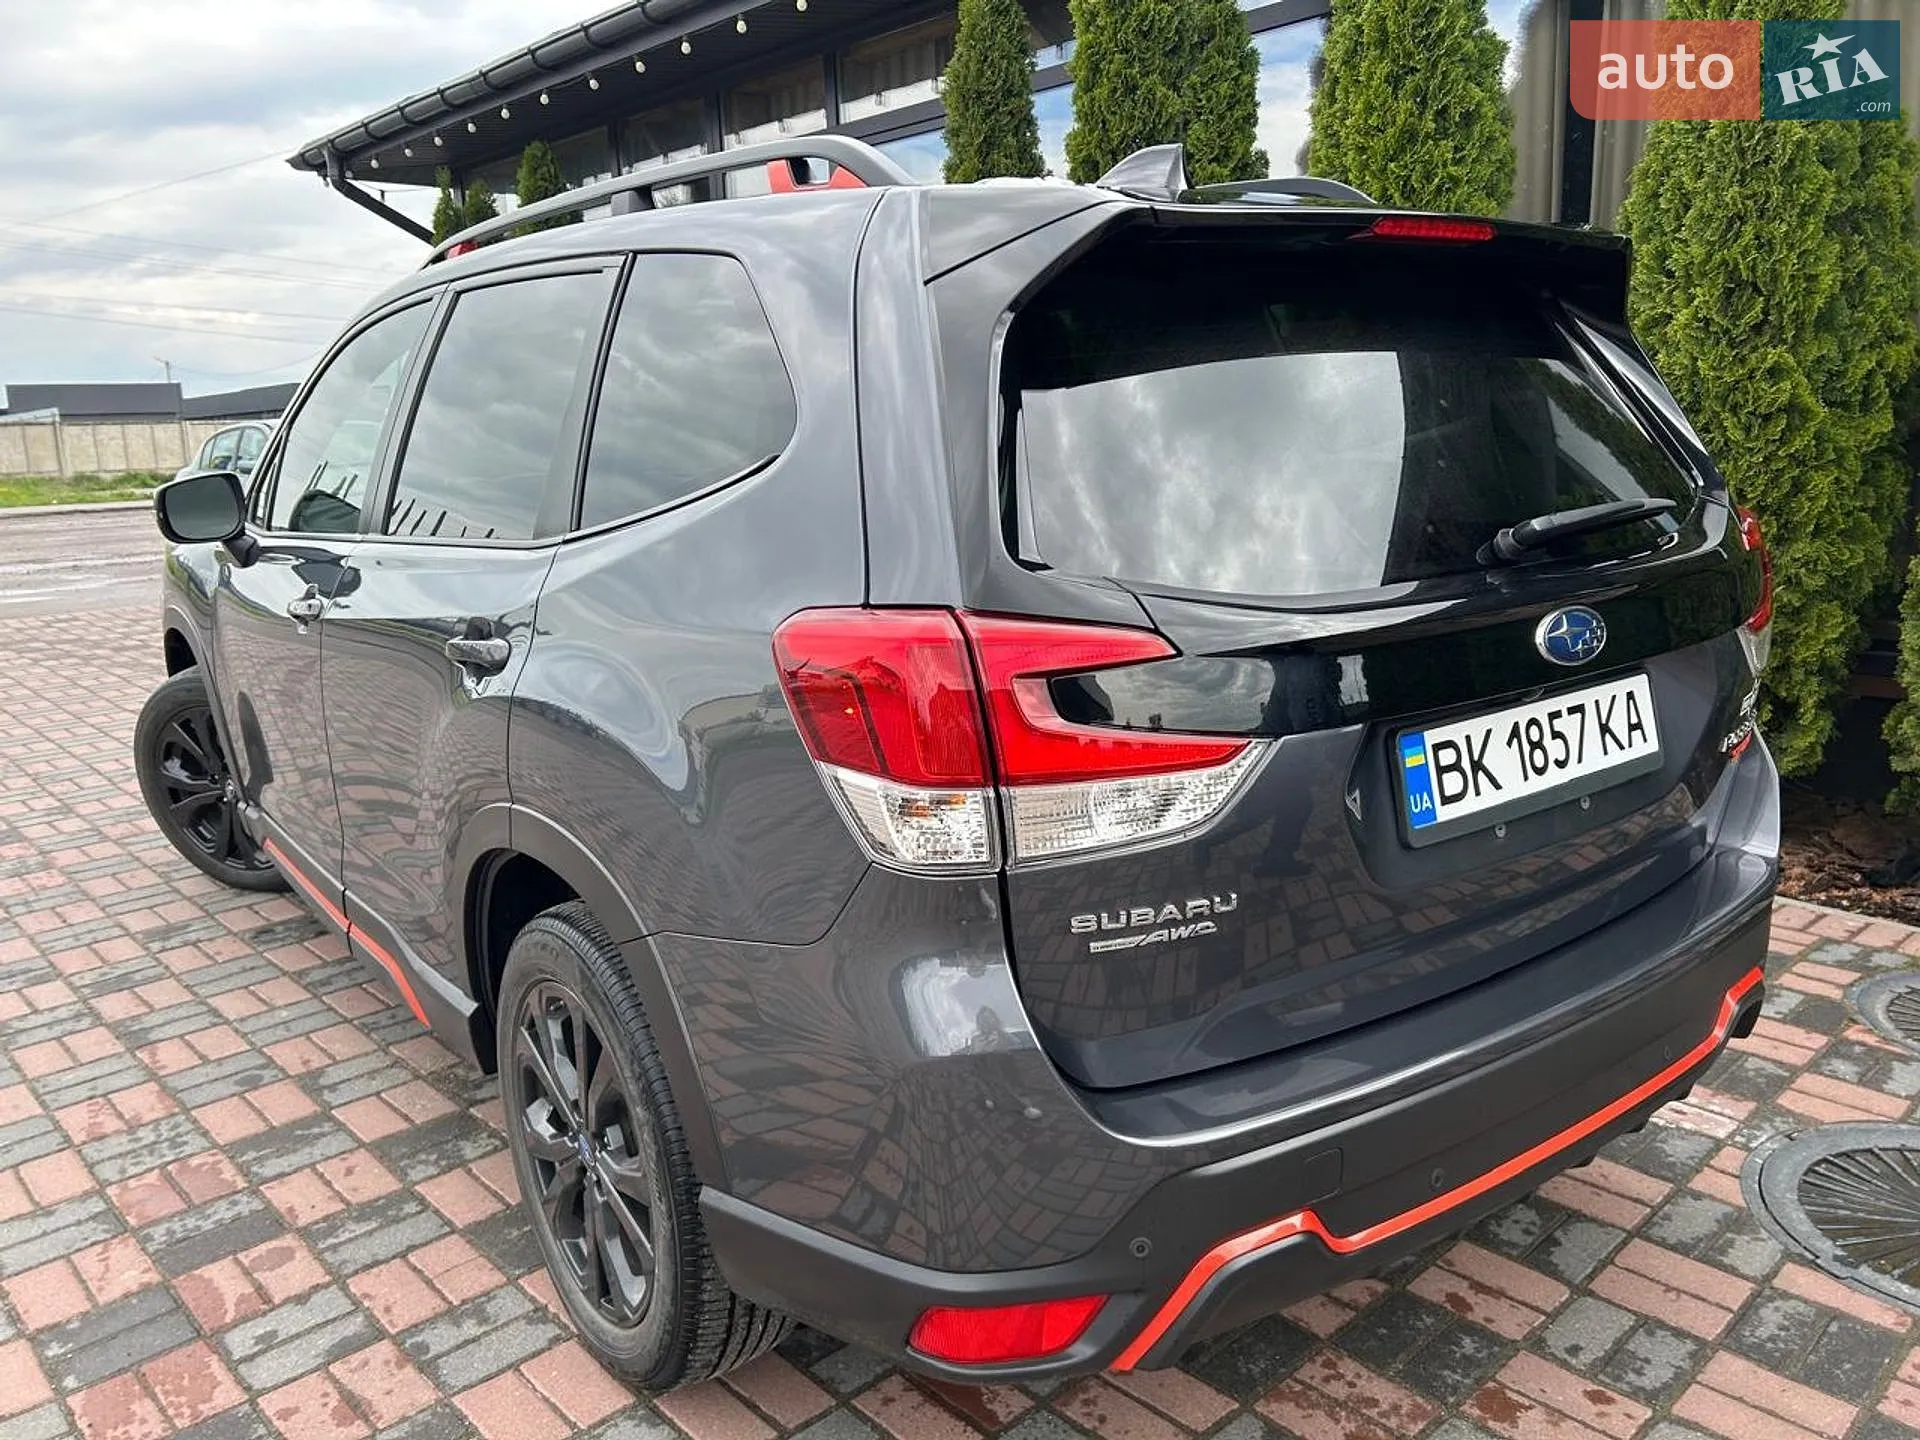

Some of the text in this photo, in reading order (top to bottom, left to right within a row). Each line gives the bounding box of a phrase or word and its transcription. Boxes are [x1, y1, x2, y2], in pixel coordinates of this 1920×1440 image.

[1431, 728, 1503, 807] BK
[1506, 703, 1587, 782] 1857
[1595, 690, 1648, 756] KA
[1410, 792, 1434, 814] UA
[1070, 892, 1238, 934] SUBARU
